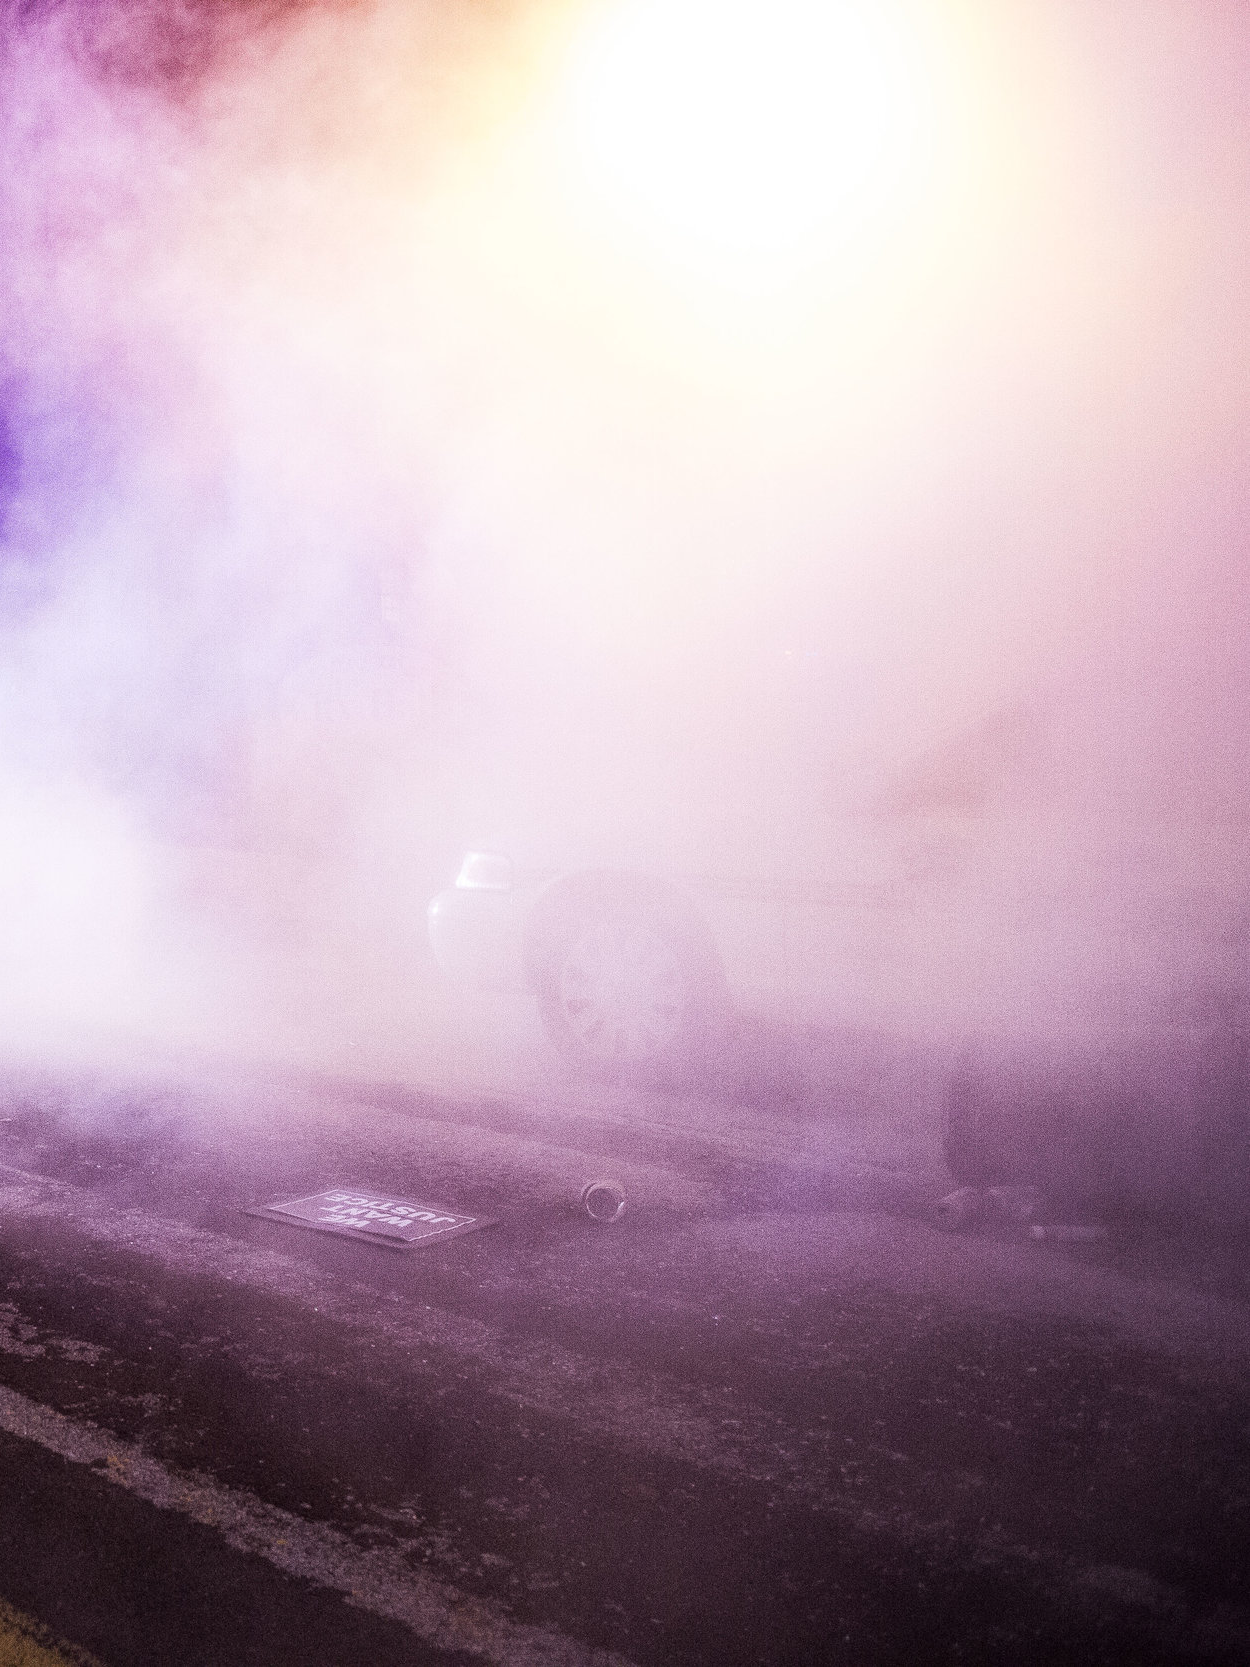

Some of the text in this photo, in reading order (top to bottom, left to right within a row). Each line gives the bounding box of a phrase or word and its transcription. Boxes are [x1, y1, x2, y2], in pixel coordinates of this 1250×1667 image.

[320, 1205, 413, 1227] WANT
[325, 1194, 456, 1223] JUSTICE
[318, 1214, 371, 1228] WE
